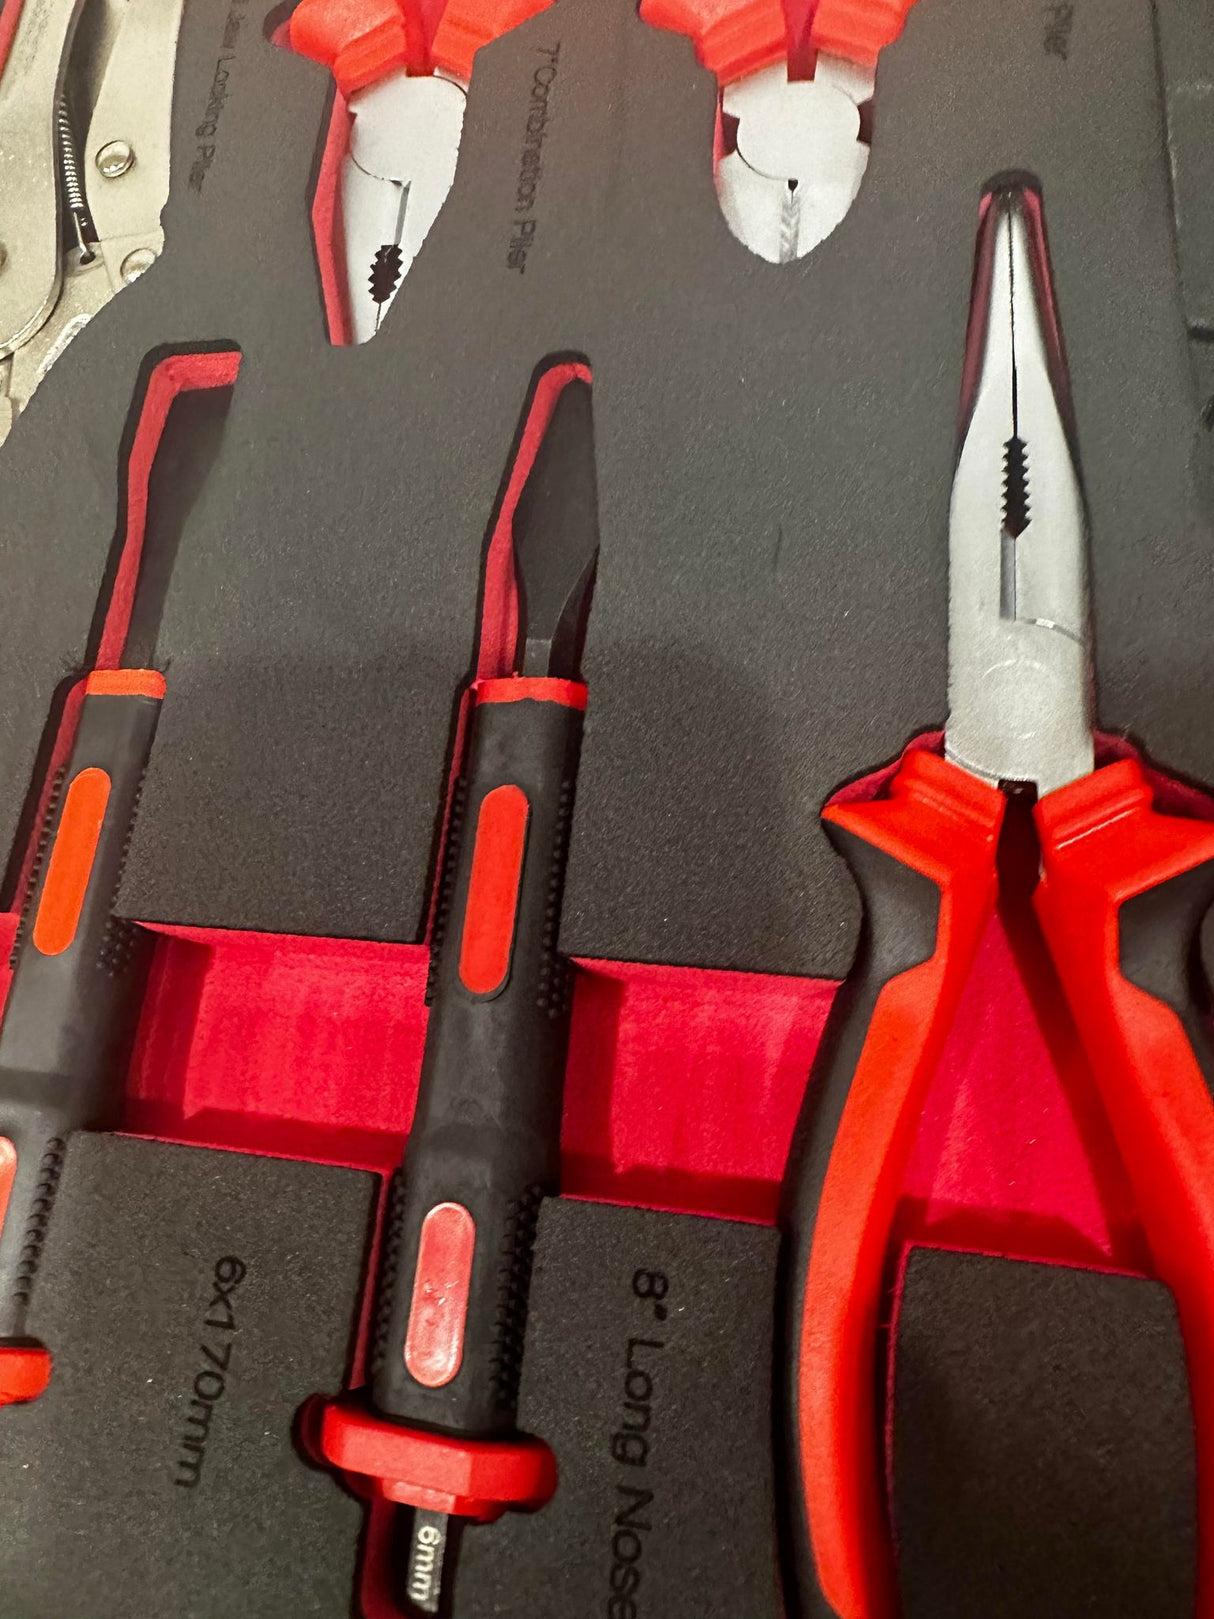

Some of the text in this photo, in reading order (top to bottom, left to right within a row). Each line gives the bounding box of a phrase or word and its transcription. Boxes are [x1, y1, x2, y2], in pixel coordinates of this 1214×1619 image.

[195, 56, 237, 137] Locking
[173, 1255, 248, 1488] 6x170mm
[610, 1338, 665, 1468] Long
[409, 1526, 442, 1601] 6mm
[607, 1484, 655, 1619] Nose
